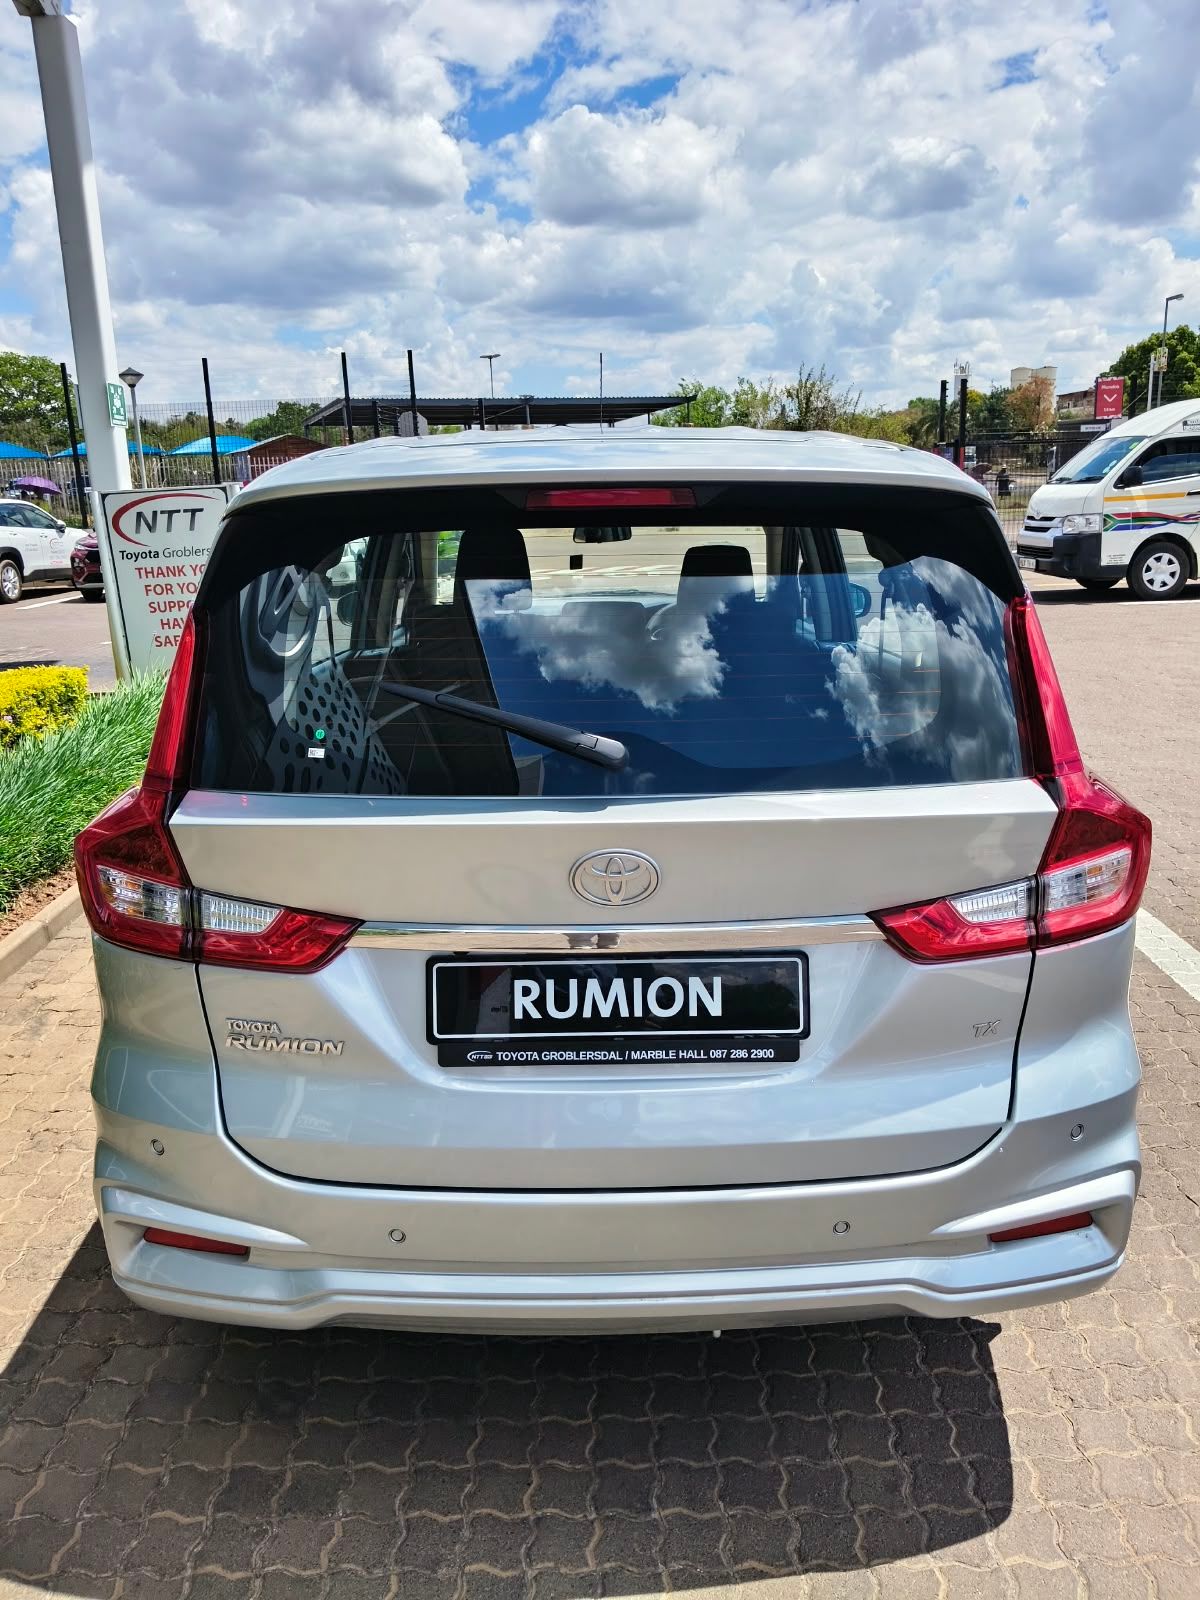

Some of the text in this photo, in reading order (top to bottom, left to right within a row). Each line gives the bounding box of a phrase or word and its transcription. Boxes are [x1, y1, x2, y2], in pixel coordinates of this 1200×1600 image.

[135, 507, 204, 534] NTT
[119, 545, 211, 562] Toyota Groblers
[135, 564, 206, 579] THANK YO
[144, 582, 198, 597] FOR YO
[154, 635, 180, 648] SAF
[513, 976, 723, 1020] RUMION
[225, 1018, 281, 1034] TOYOTA
[972, 1019, 1001, 1038] TX
[225, 1033, 344, 1056] RUMION
[496, 1051, 540, 1061] TOYOTA
[541, 1051, 623, 1061] GROBLERSDAL
[631, 1050, 676, 1060] MARBLE
[678, 1049, 708, 1059] HALL
[709, 1049, 727, 1058] 087
[730, 1048, 749, 1058] 286
[750, 1048, 775, 1059] 2900
